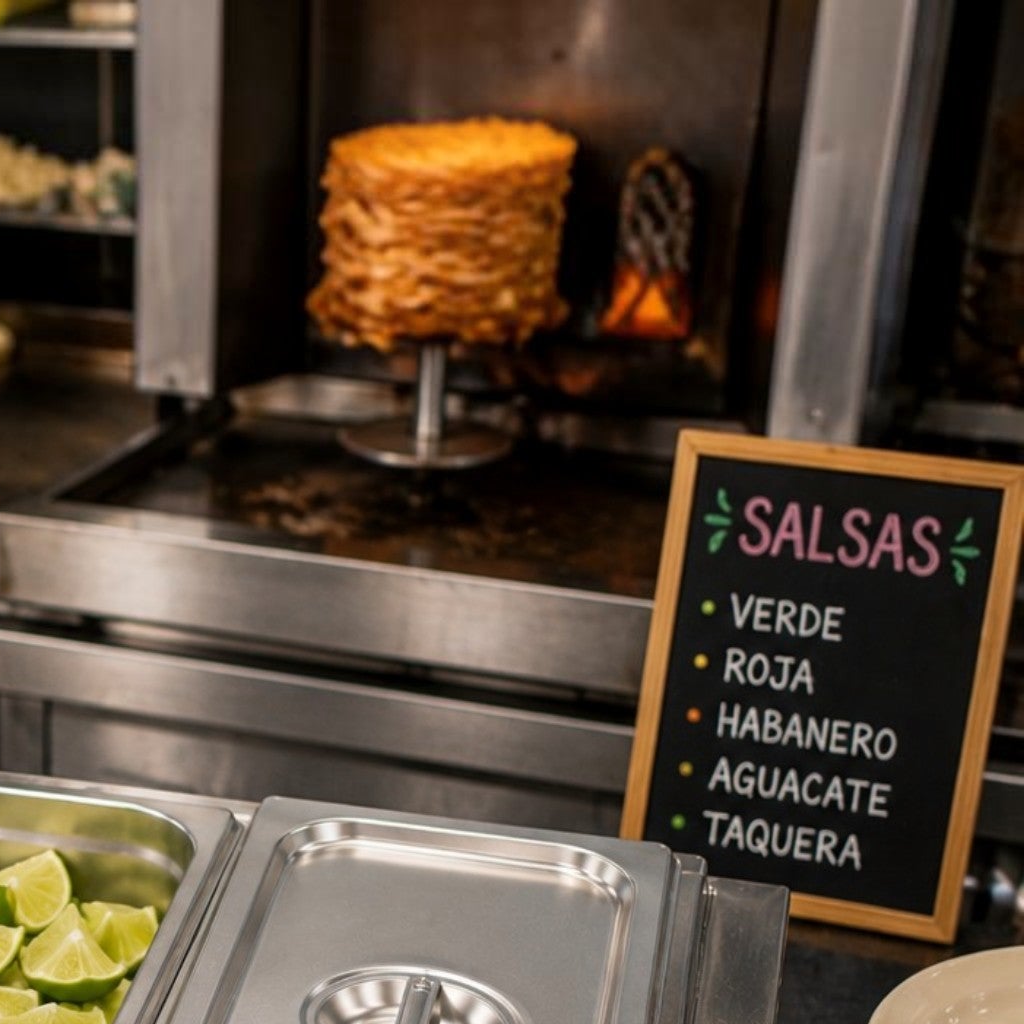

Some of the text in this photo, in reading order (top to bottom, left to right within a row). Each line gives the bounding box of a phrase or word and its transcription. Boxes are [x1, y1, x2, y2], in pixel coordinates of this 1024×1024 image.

[738, 496, 942, 577] SALSAS
[730, 592, 845, 642] VERDE
[723, 647, 814, 694] ROJA
[716, 701, 897, 761] HABANERO
[708, 757, 891, 818] AGUACATE
[702, 810, 862, 870] TAQUERA
